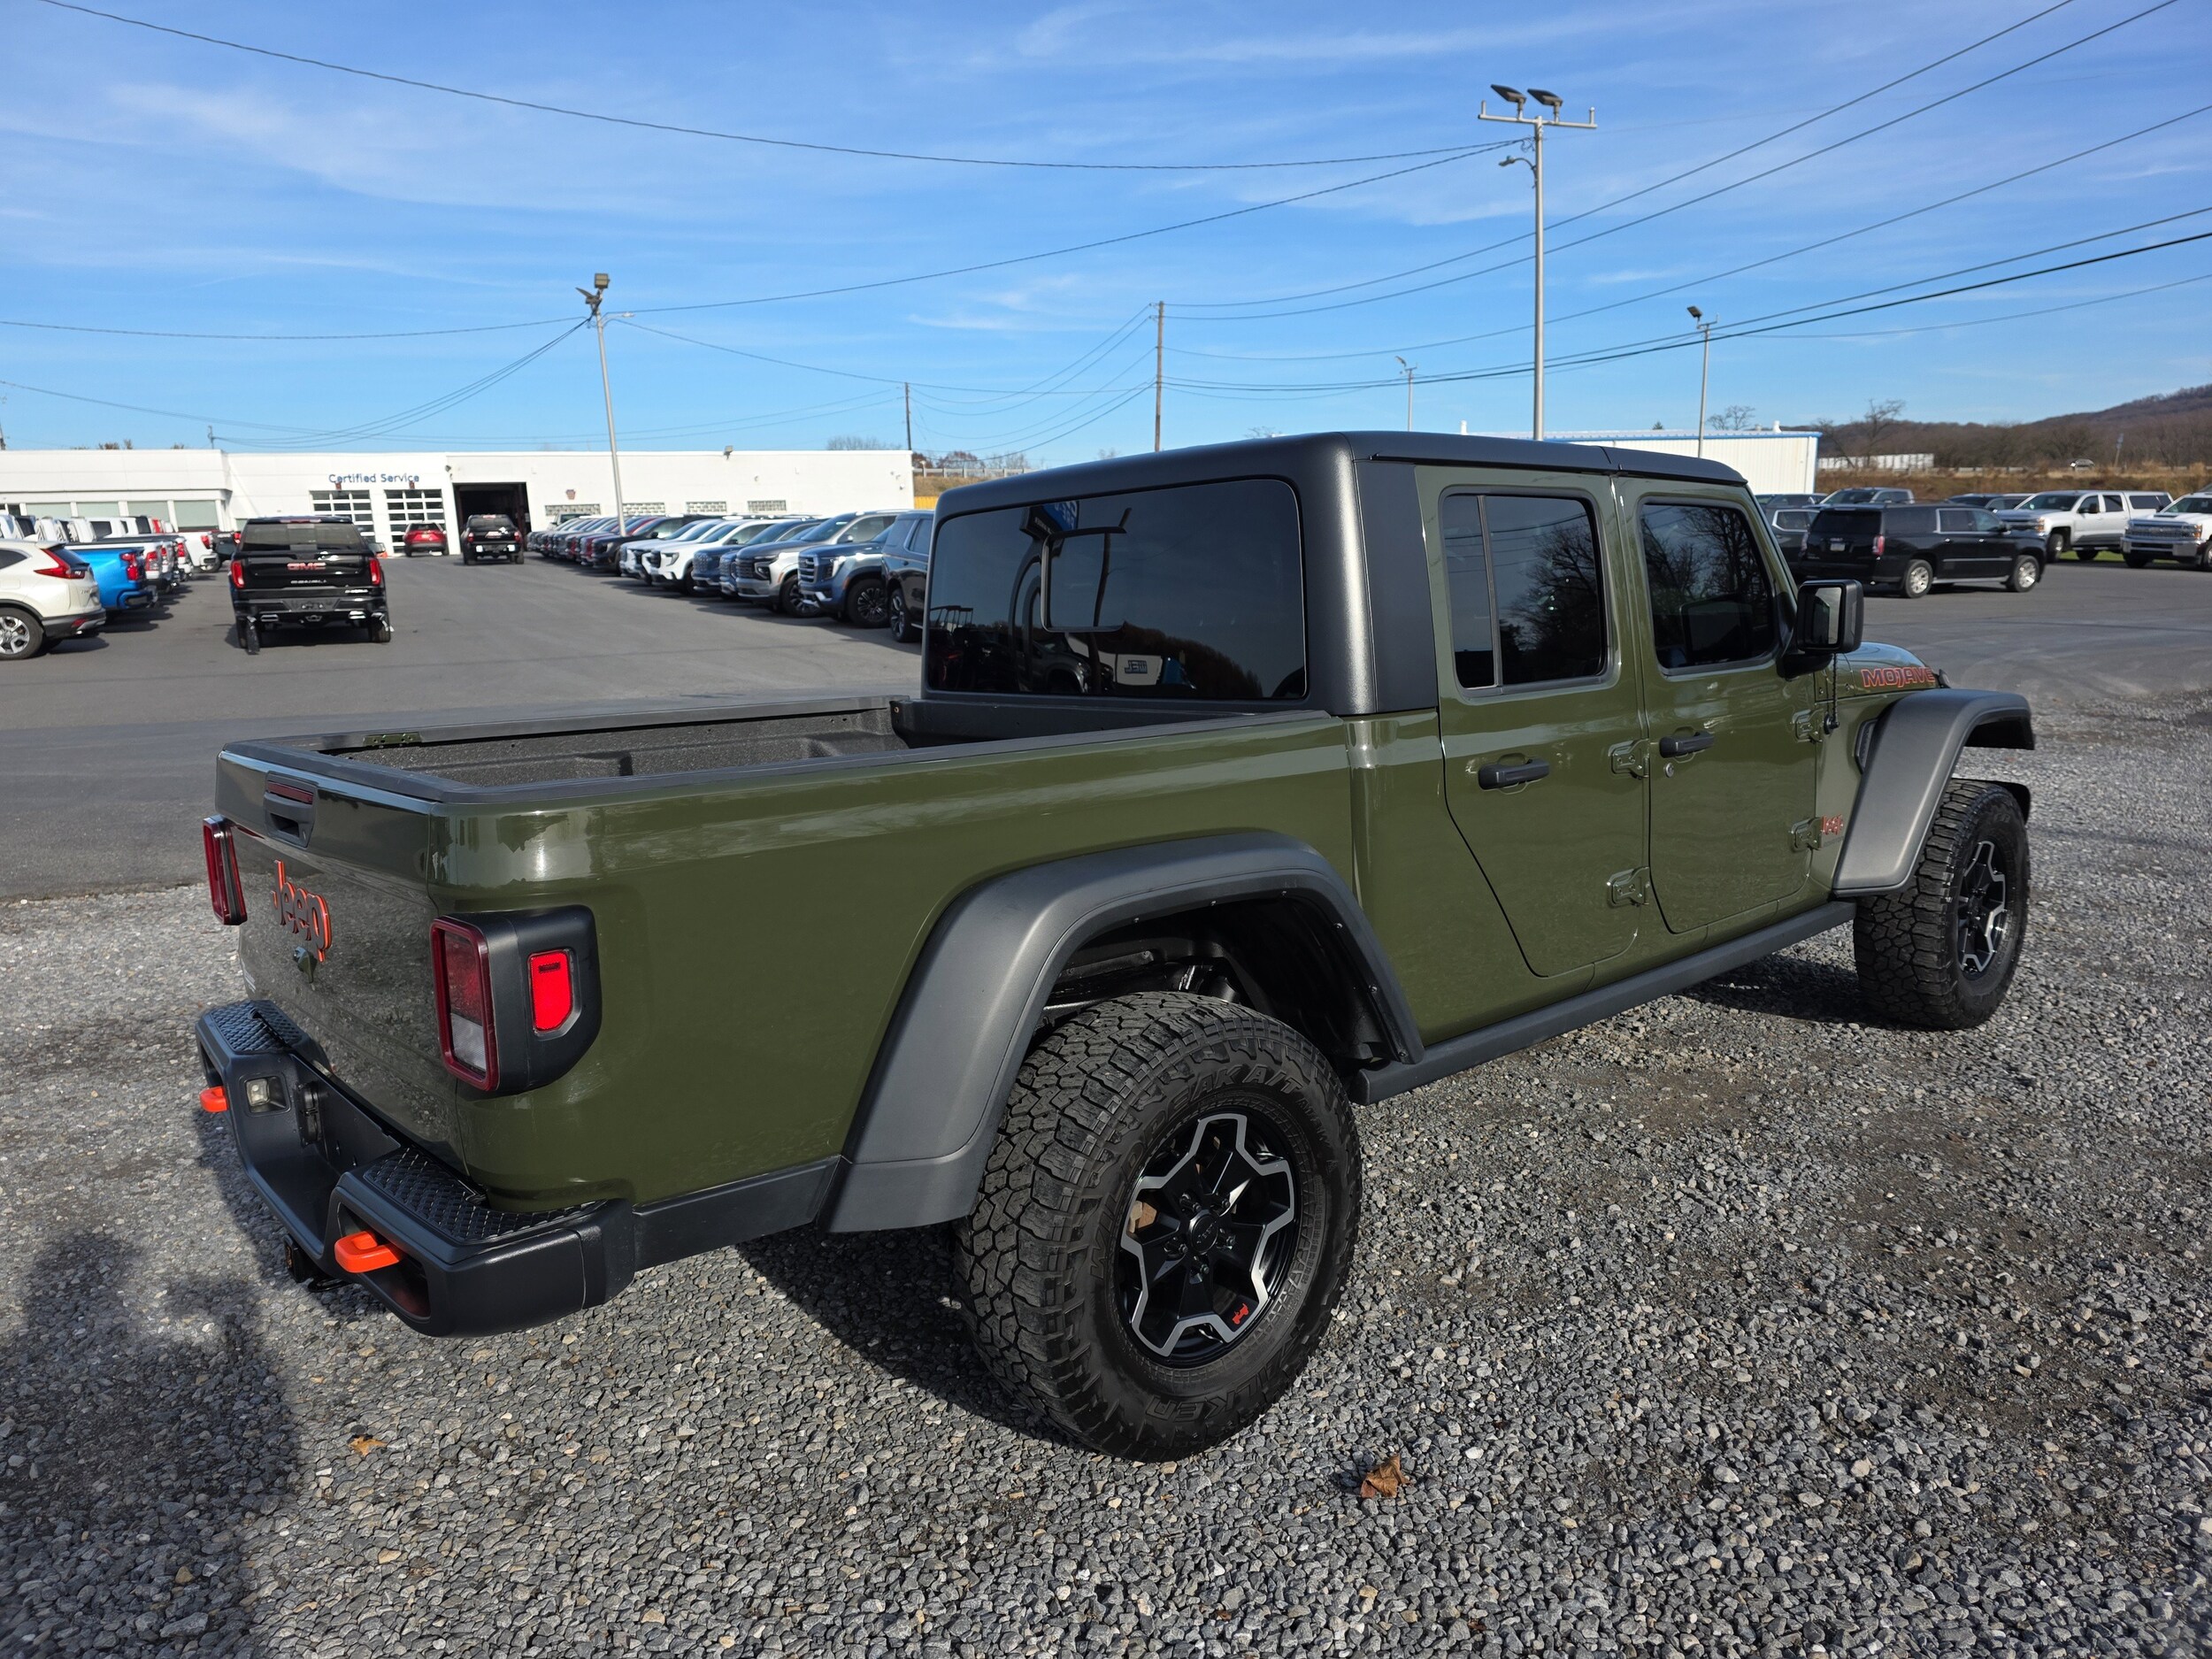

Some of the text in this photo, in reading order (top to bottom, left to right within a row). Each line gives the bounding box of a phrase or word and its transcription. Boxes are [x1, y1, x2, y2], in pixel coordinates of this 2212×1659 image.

[328, 472, 420, 483] Certified Service
[287, 562, 326, 571] GMC
[1861, 665, 1936, 688] MOJAVE
[270, 859, 332, 963] Jeep
